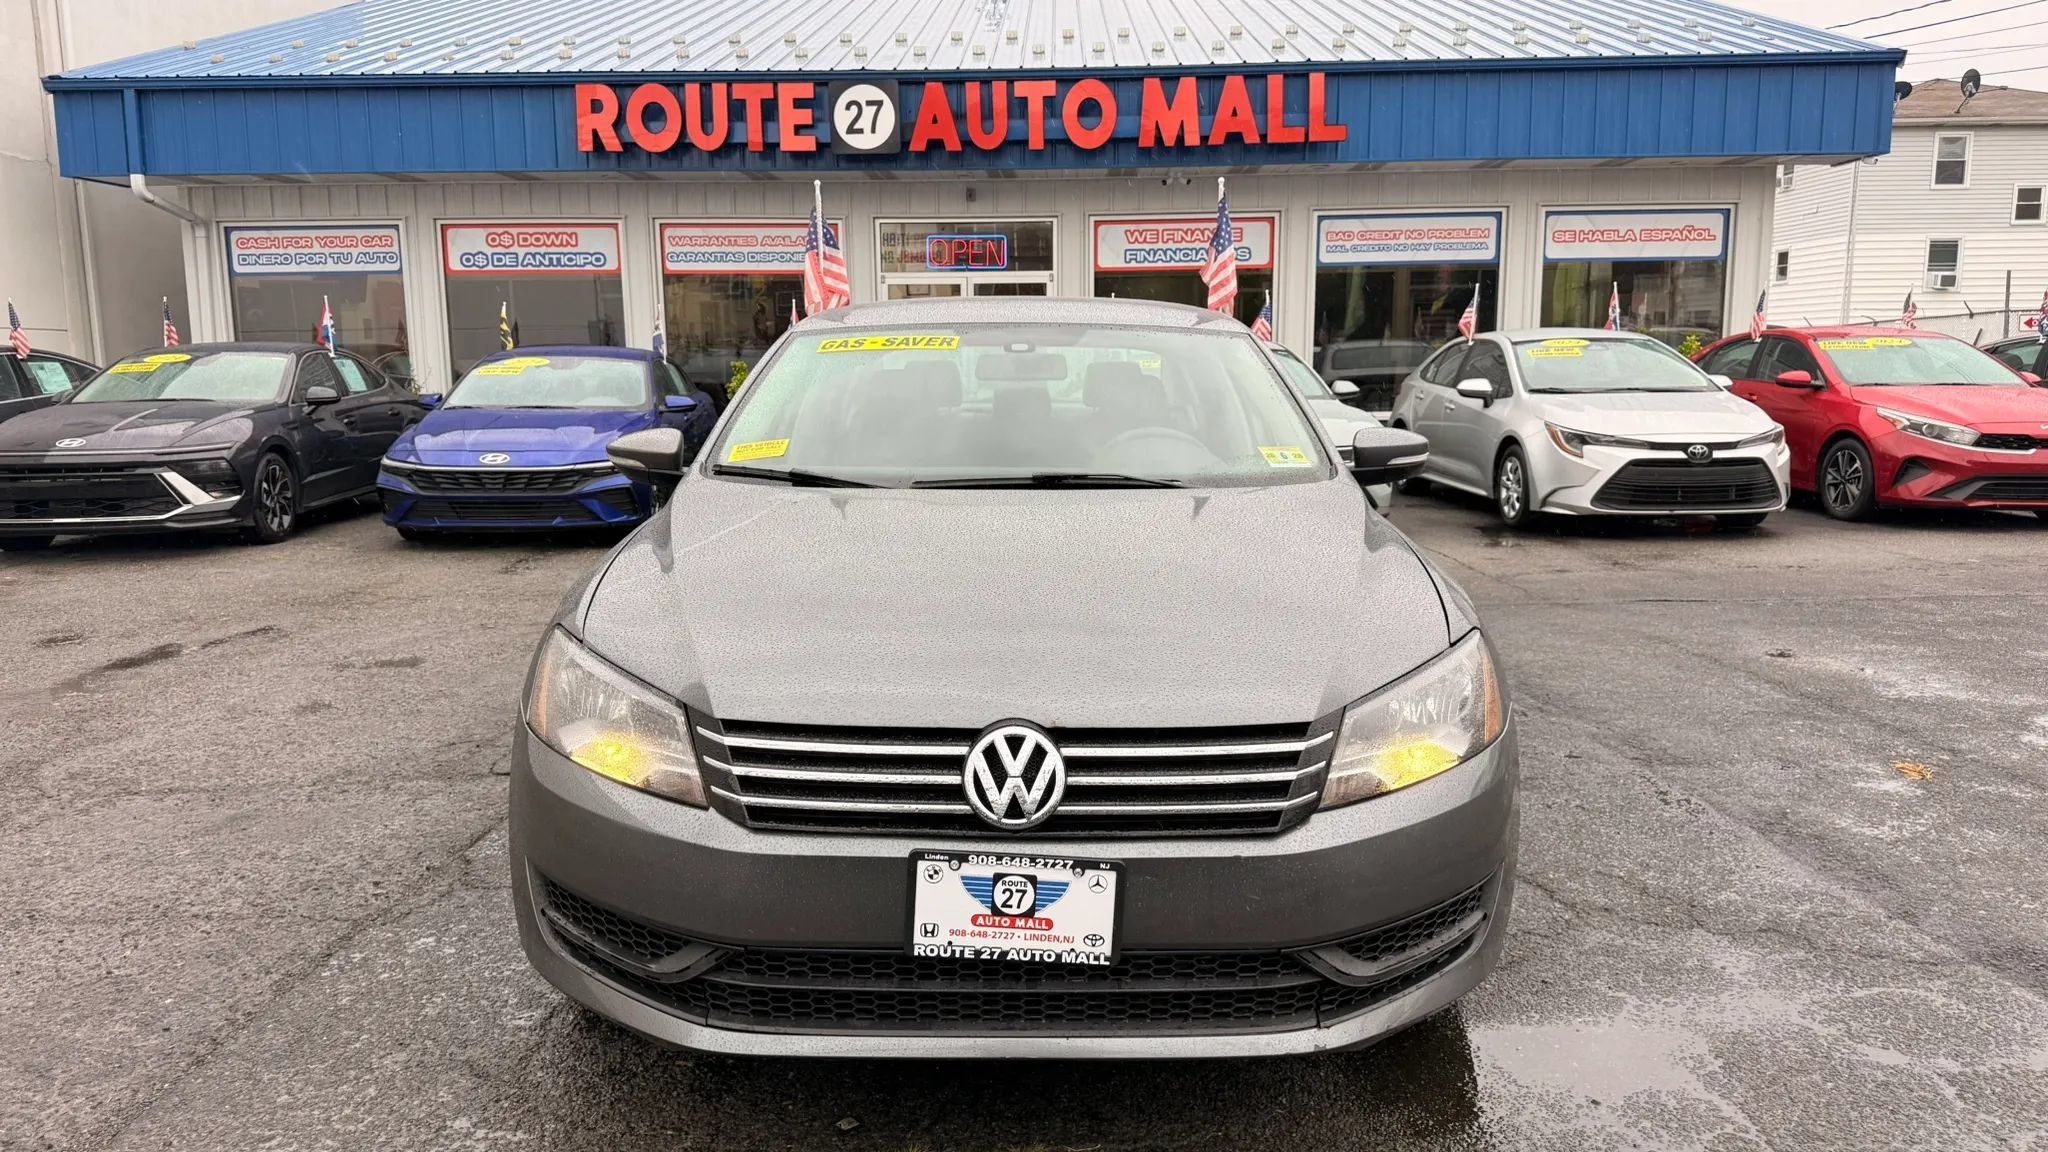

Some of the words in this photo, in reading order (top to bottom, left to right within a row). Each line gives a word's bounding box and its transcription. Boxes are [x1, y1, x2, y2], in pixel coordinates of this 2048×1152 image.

[575, 82, 817, 153] ROUTE
[844, 99, 884, 135] 27
[908, 78, 1118, 152] AUTO
[1138, 72, 1348, 147] MALL
[517, 232, 578, 247] DOWN
[668, 235, 759, 248] WARRANTIES
[760, 235, 807, 247] AVAILA
[1125, 228, 1158, 244] WE
[1161, 227, 1243, 244] FINANE
[1326, 230, 1354, 242] BAD
[1356, 229, 1403, 241] CREDIT
[1404, 229, 1426, 240] NO
[1427, 228, 1490, 239] PROBLEM
[1552, 230, 1577, 243] SE
[1578, 229, 1636, 243] HABLA
[1639, 225, 1717, 243] ESPAÑOL
[236, 237, 280, 249] CASH
[282, 236, 313, 249] FOR
[315, 236, 358, 249] YOUR
[360, 235, 394, 248] CAR
[1350, 244, 1392, 253] CREDITO
[1393, 243, 1409, 252] NO
[1410, 242, 1432, 251] HAY
[1433, 241, 1489, 250] PROBLEMA
[238, 253, 292, 266] DINERO
[295, 253, 327, 266] POR
[329, 252, 352, 265] TU
[355, 251, 398, 265] AUTO
[491, 252, 518, 267] DE
[521, 252, 607, 267] ANTICIPO
[667, 251, 745, 263] GARANTIAS
[747, 251, 806, 263] DISPONI
[929, 238, 1005, 267] OPEN
[1125, 247, 1252, 264] FINANCIAS
[821, 338, 867, 350] GAS
[880, 336, 957, 347] SAVER
[924, 853, 949, 861] Linden
[968, 855, 1074, 870] 908-648-2727
[1001, 879, 1028, 888] ROUTE
[1000, 888, 1028, 909] 27
[976, 915, 1011, 927] AUTO
[1014, 918, 1049, 930] MALL
[949, 929, 1015, 941] 908-648-2727
[914, 944, 976, 959] ROUTE
[980, 947, 1001, 960] 27
[1006, 949, 1056, 963] AUTO
[1061, 951, 1110, 966] MALL
